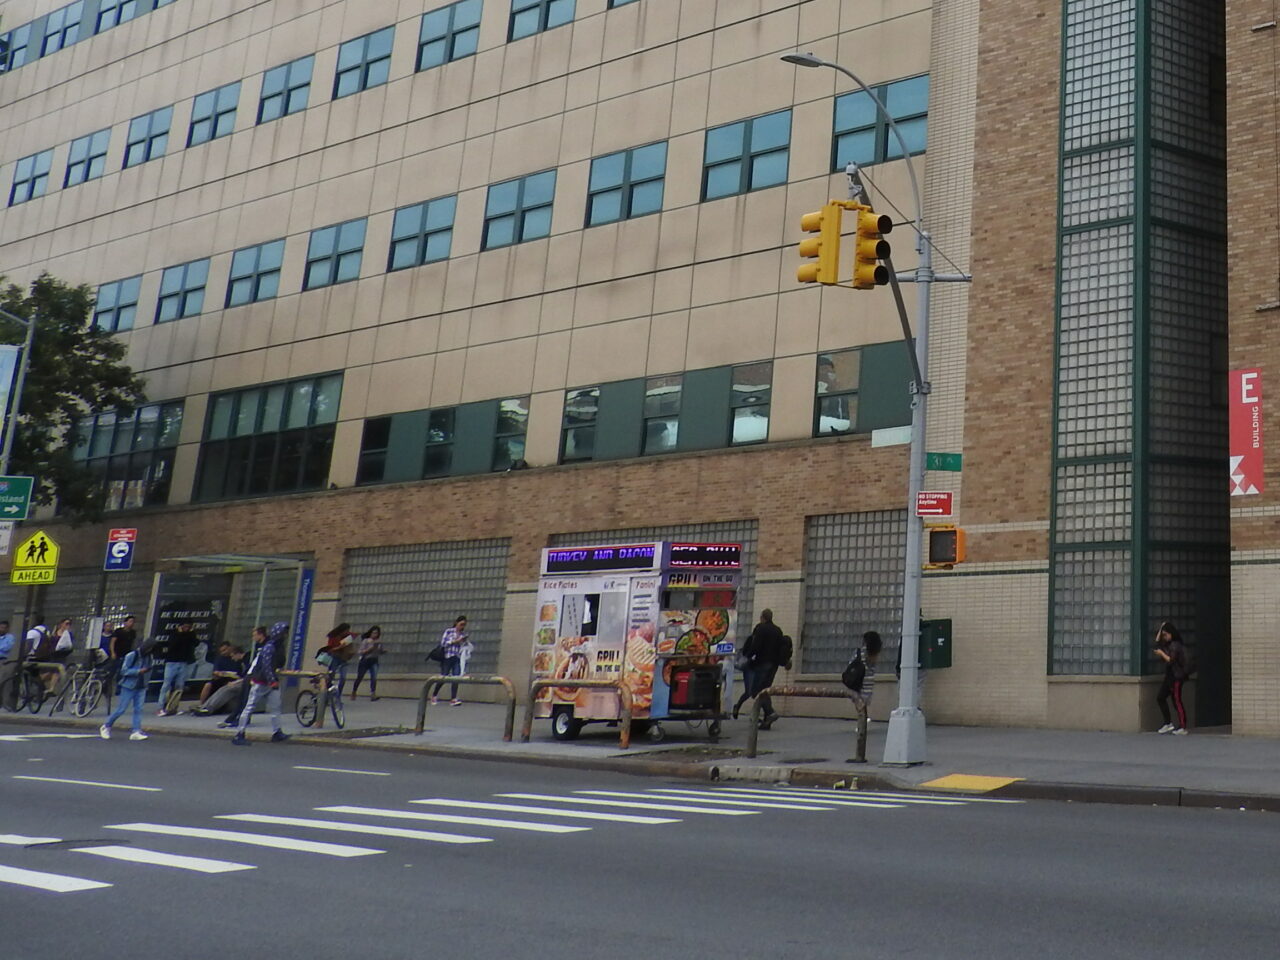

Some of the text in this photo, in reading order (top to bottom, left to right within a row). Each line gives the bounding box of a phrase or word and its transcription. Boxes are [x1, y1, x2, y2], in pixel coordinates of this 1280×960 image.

[1242, 372, 1259, 404] E
[1252, 406, 1260, 449] BUILDING
[17, 570, 51, 581] AHEAD
